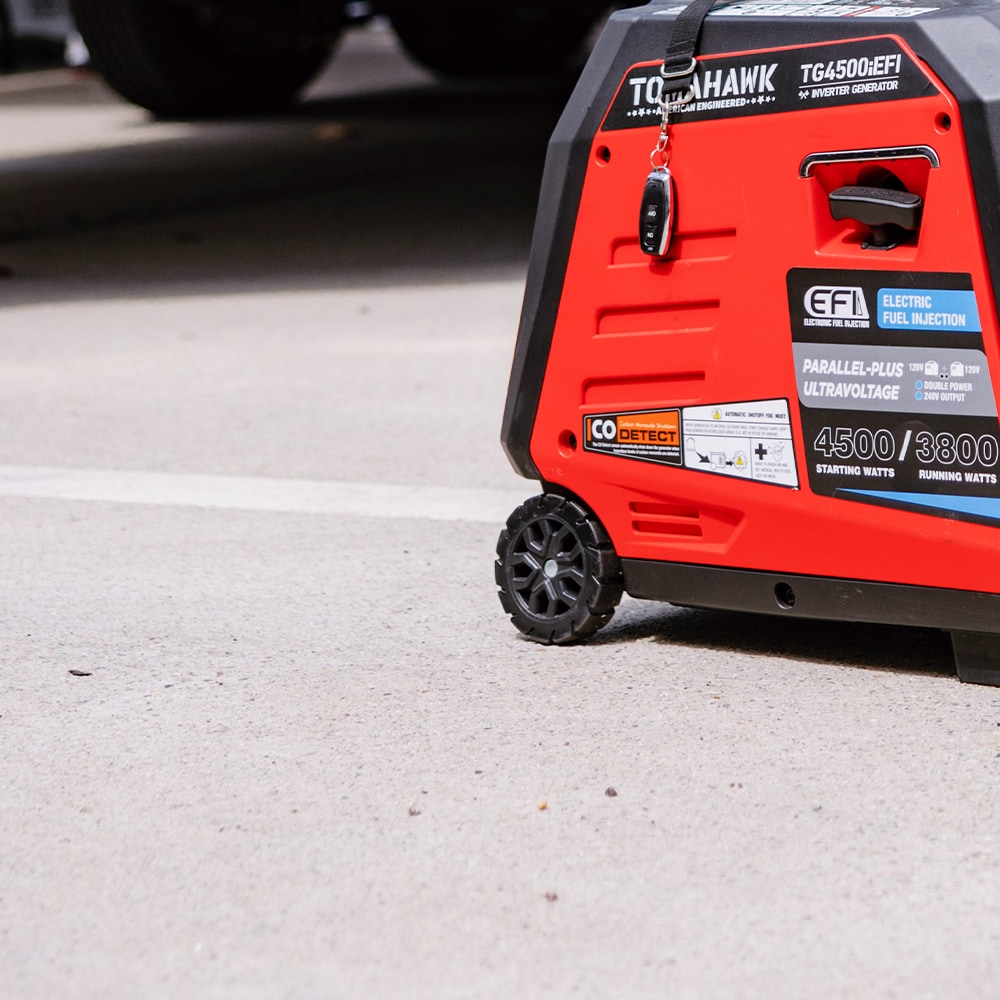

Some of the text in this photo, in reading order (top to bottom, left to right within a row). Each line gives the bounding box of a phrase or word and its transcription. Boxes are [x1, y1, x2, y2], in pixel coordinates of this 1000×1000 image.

[801, 53, 902, 83] TG4500iEFI
[811, 80, 899, 99] INVERTER GENERATOR
[656, 97, 746, 116] AERICAN ENGINEERED
[808, 288, 861, 317] EFI
[882, 294, 933, 308] ELECTRIC
[803, 318, 870, 329] ELECTRONIC FUEL INJECTION
[882, 311, 966, 327] FUEL INJECTION
[802, 358, 904, 377] PARALLEL-PLUS
[908, 363, 981, 374] 120V 120V
[803, 380, 900, 400] ULTRAVOLTAGE
[924, 380, 973, 391] DOUBLE POWER
[923, 392, 966, 402] 240V OUTPUT
[591, 419, 617, 440] CO
[619, 429, 676, 442] DETECT
[815, 463, 896, 477] STARTING WATTS
[918, 469, 998, 484] RUNNING WATTS
